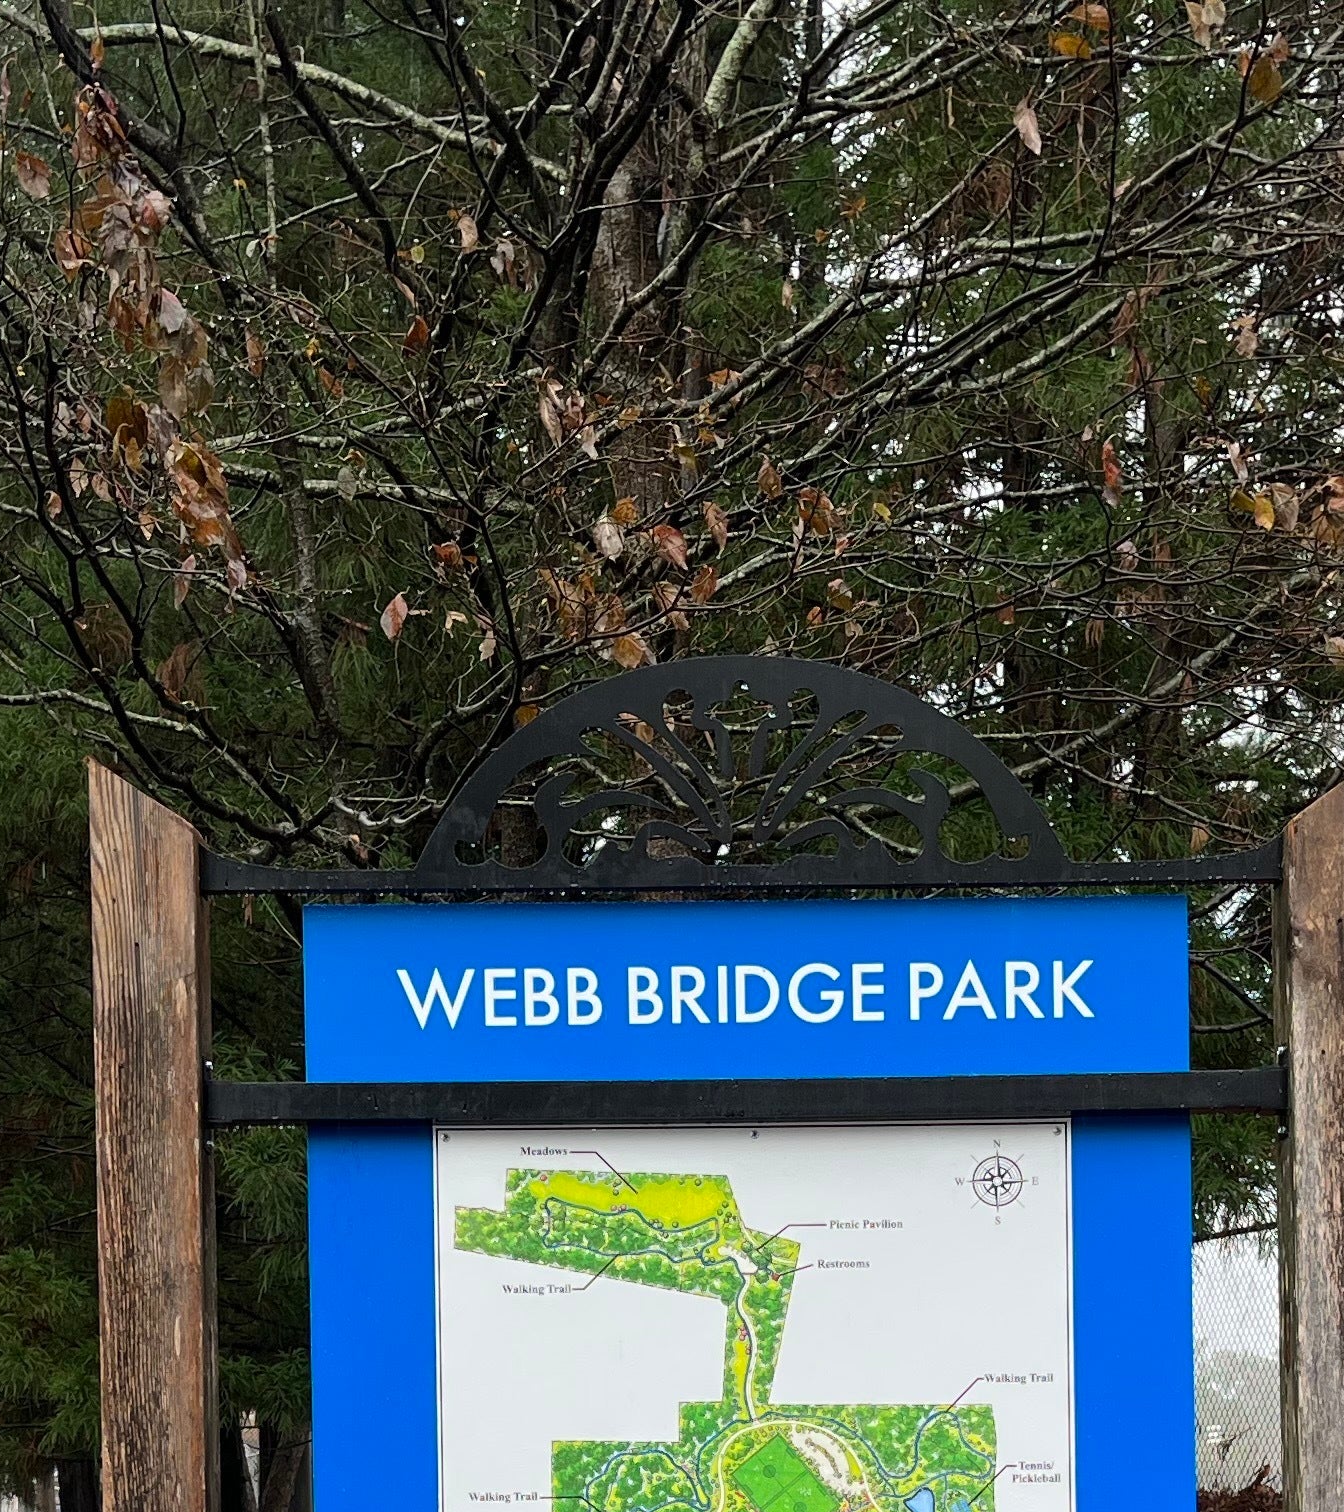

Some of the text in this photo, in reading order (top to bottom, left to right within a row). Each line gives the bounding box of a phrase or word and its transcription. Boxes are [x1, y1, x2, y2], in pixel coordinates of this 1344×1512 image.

[396, 959, 1095, 1029] WEBB BRIDGE PARK
[993, 1139, 1002, 1149] N
[520, 1146, 568, 1156] Meadows
[954, 1177, 966, 1187] W
[1031, 1175, 1040, 1186] E
[829, 1219, 903, 1230] Picnic Pavilion
[994, 1215, 1002, 1226] S
[817, 1258, 871, 1269] Restrooms
[502, 1284, 572, 1296] Walking Trail
[984, 1372, 1054, 1385] Walking Trail
[1012, 1473, 1062, 1484] Pickleball
[468, 1491, 538, 1504] Walking Trail
